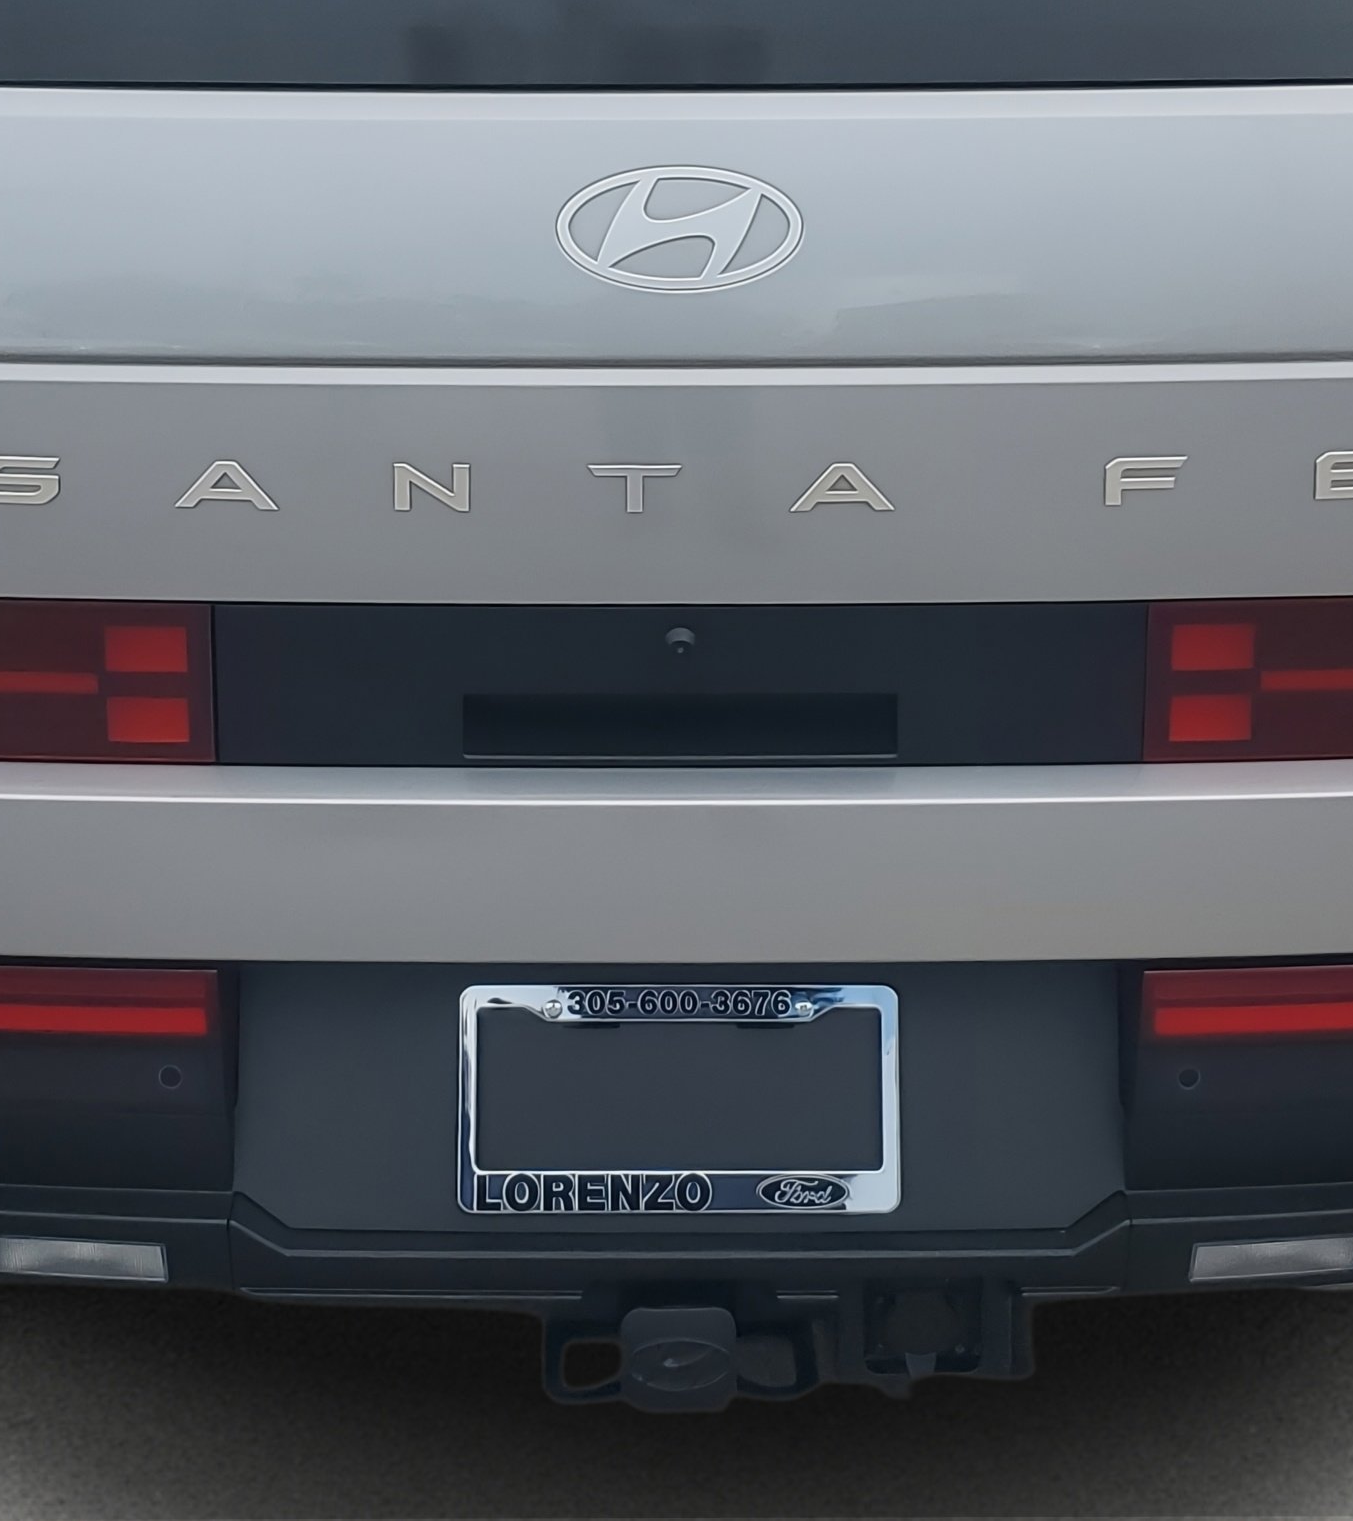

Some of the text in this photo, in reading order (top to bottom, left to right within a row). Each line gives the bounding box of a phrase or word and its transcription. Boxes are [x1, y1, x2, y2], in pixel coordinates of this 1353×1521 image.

[566, 989, 792, 1017] 305-600-3676
[472, 1171, 833, 1212] LORENZO Ford
